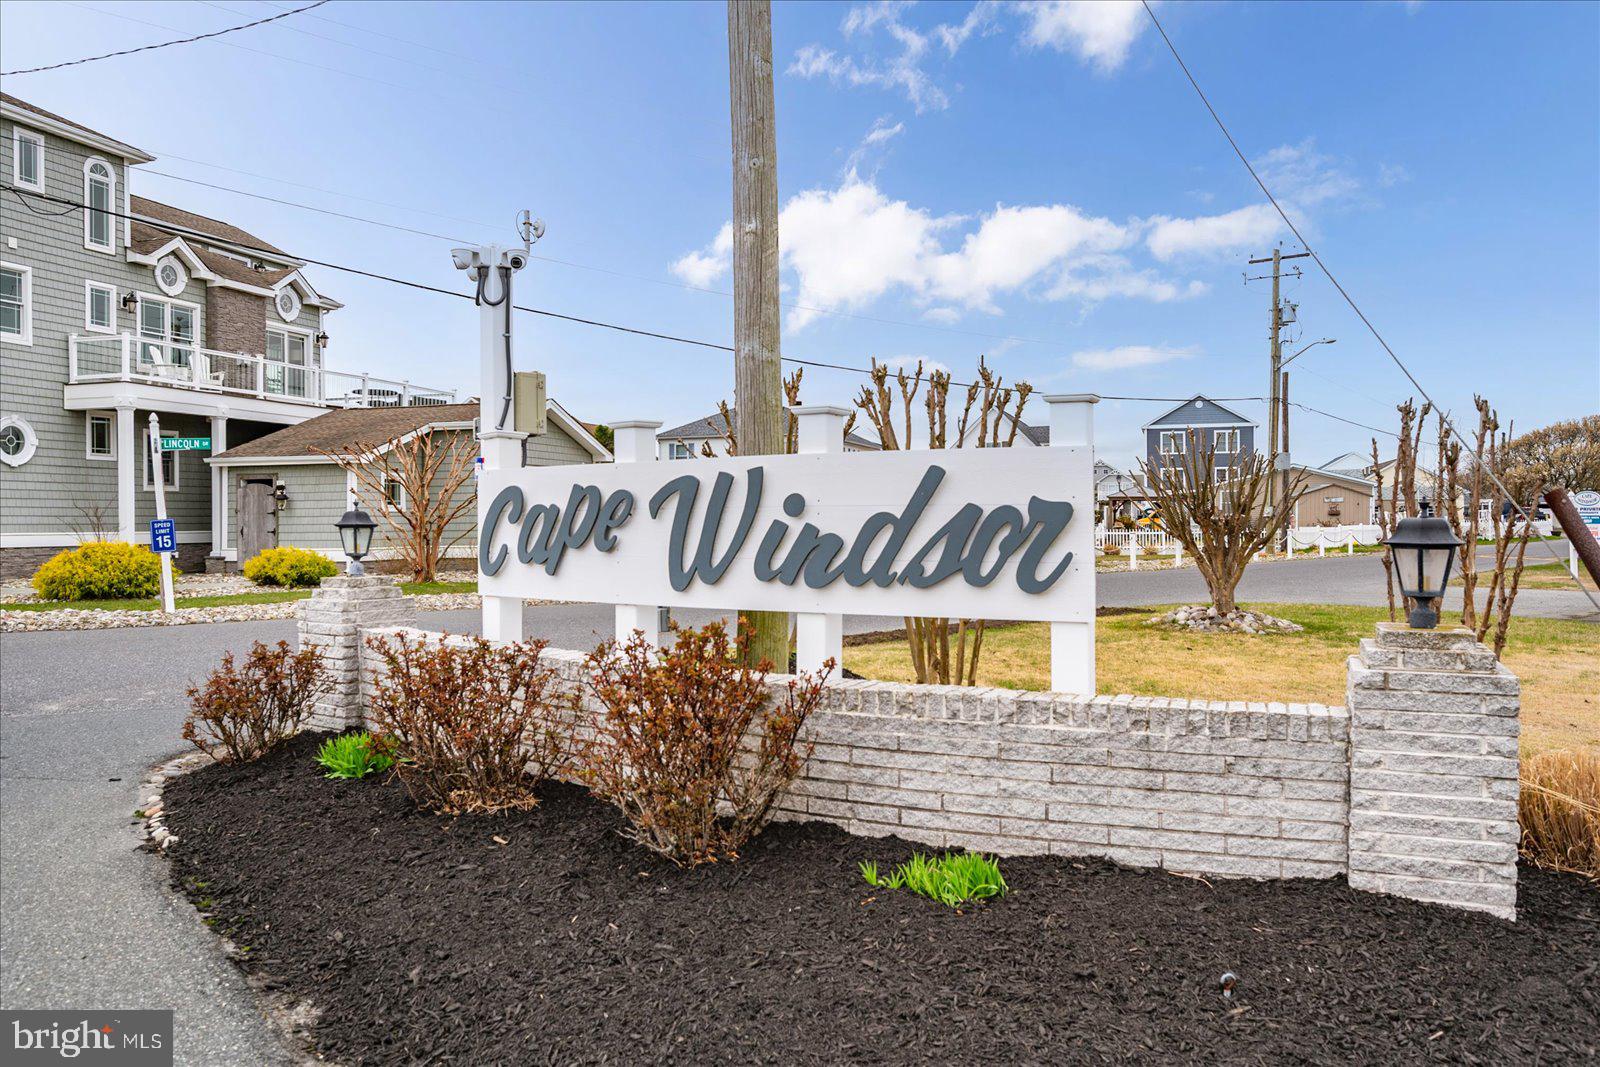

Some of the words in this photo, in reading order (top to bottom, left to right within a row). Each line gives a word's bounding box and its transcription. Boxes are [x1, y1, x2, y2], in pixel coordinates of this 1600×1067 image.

[164, 439, 200, 449] LINCOLN
[479, 484, 636, 578] Cape
[649, 464, 1075, 596] Windsor
[156, 535, 172, 548] 15
